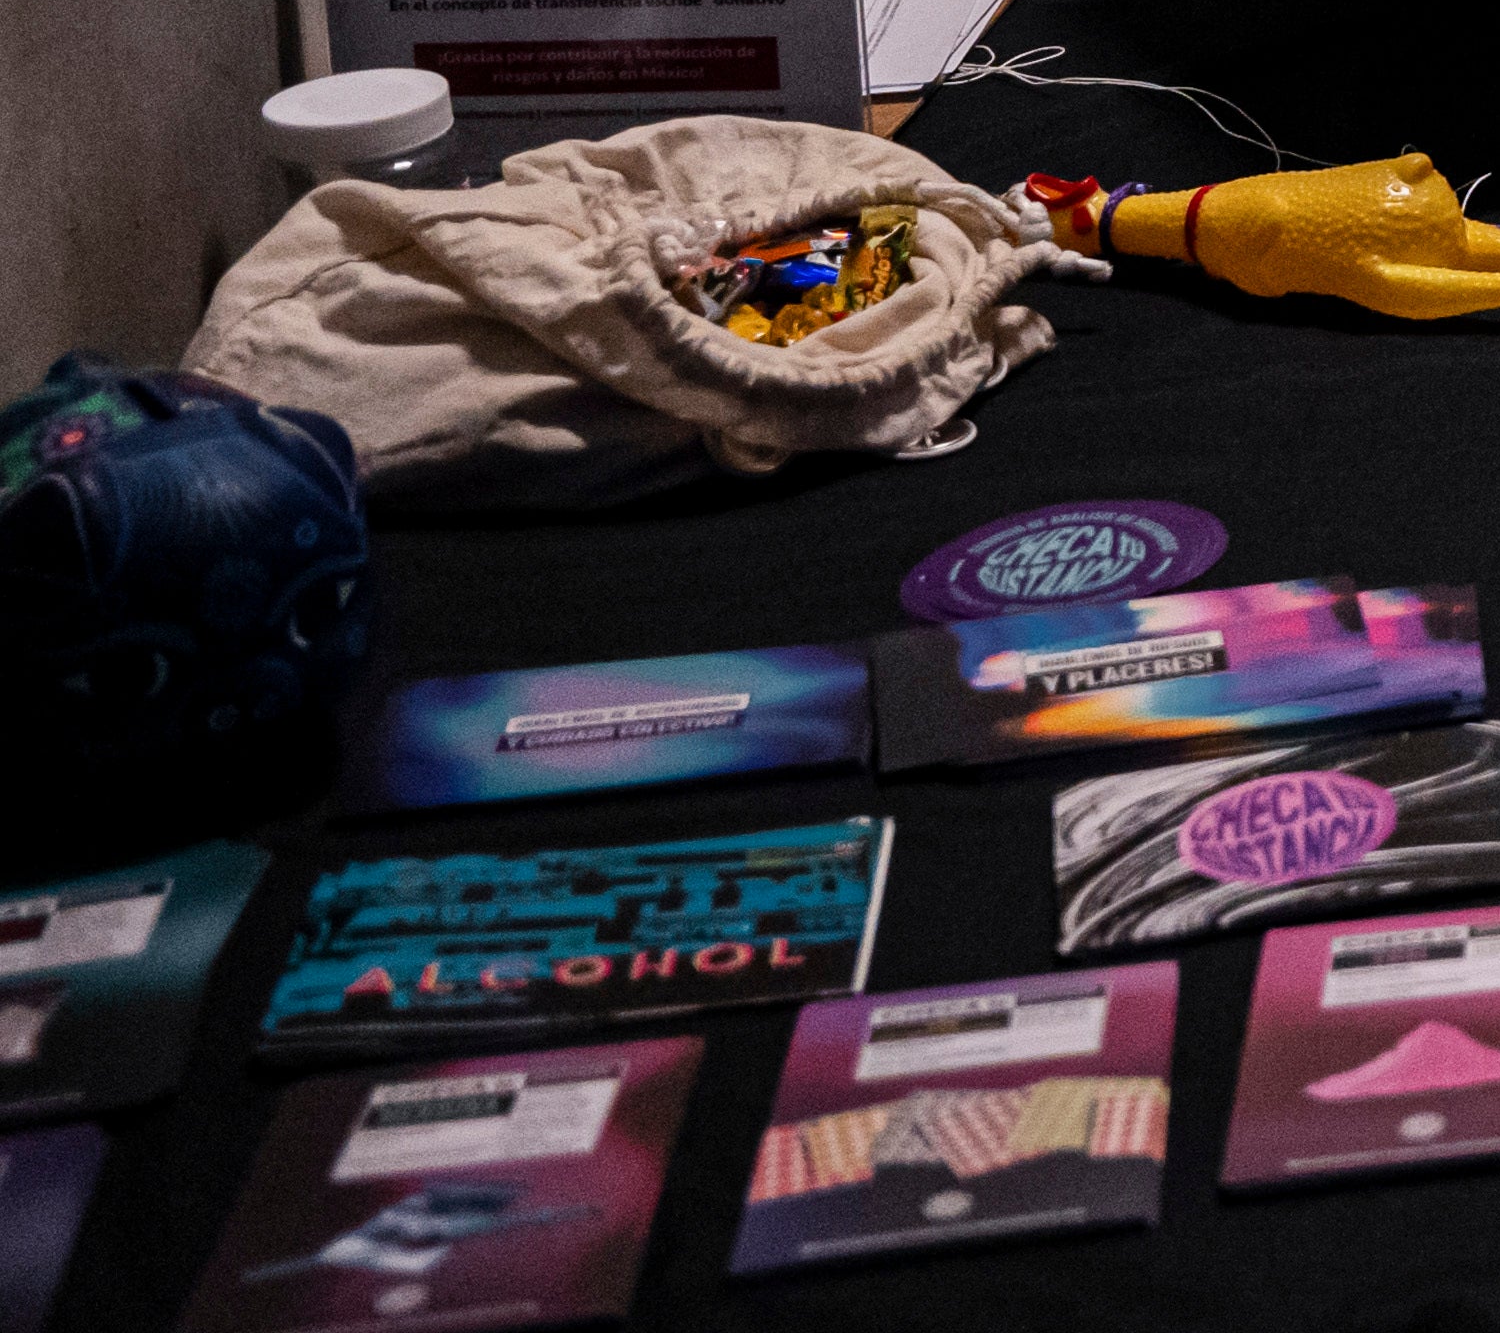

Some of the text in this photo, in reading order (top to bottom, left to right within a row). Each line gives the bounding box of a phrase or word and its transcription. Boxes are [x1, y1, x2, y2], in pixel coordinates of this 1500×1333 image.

[507, 51, 535, 66] por
[737, 44, 757, 59] de
[986, 525, 1112, 567] CHECA
[1067, 652, 1214, 690] PLACERES!
[1189, 779, 1332, 841] CHECA
[344, 936, 806, 996] ALCOHOL
